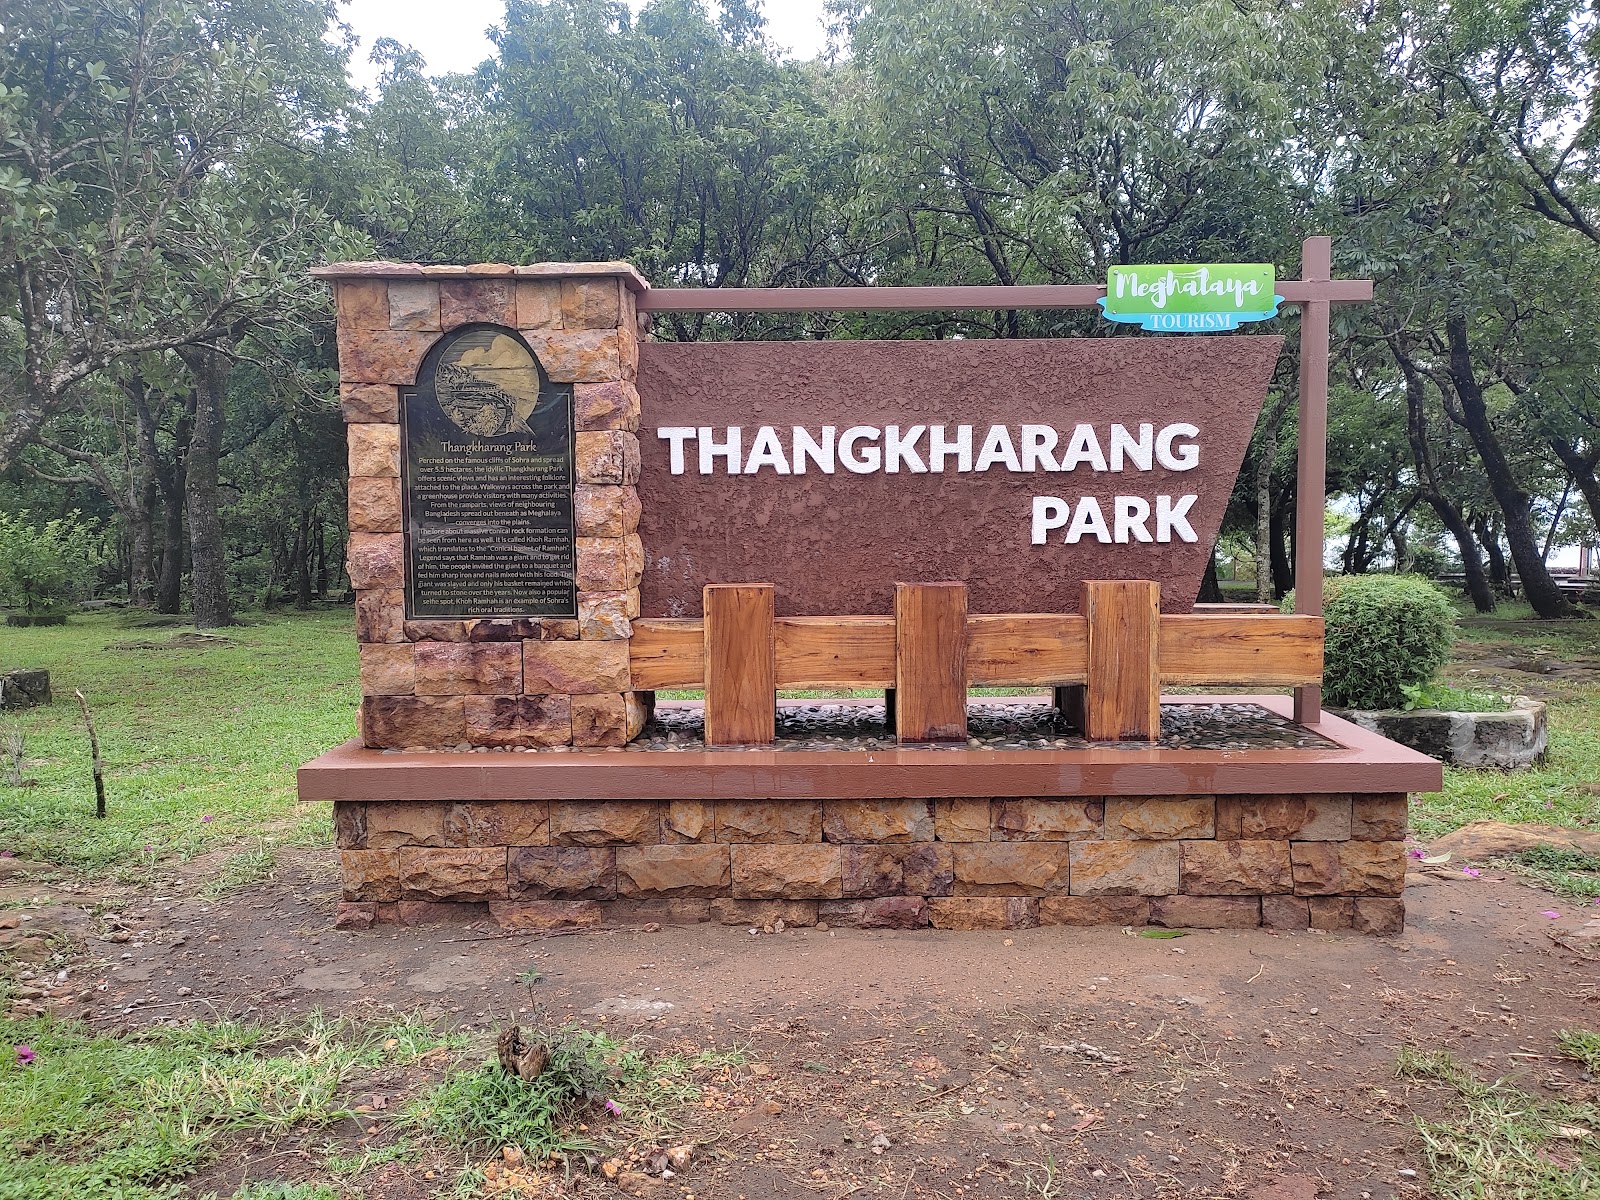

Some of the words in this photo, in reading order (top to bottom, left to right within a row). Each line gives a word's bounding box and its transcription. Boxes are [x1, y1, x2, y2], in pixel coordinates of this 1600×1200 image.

[1116, 267, 1264, 309] Meghalaya
[1151, 313, 1231, 329] TOURISM
[440, 440, 512, 456] Thangkharang
[514, 440, 537, 452] Park
[657, 422, 1200, 476] THANGKHARANG
[485, 466, 504, 474] idyllic
[504, 466, 548, 474] Thangkharang
[461, 484, 479, 492] place.
[543, 483, 558, 491] park
[421, 493, 458, 501] greenhouse
[458, 492, 483, 501] provide
[459, 501, 489, 509] ramparts,
[515, 501, 555, 509] neighbouring
[424, 510, 460, 518] Bangladesh
[461, 510, 482, 518] spread
[528, 510, 561, 518] Meghalaya
[511, 519, 532, 527] plains.
[1031, 494, 1198, 546] PARK
[513, 554, 529, 562] giant
[549, 554, 560, 562] get
[450, 563, 471, 571] people
[441, 572, 459, 580] sharp
[546, 589, 570, 597] popular
[513, 597, 539, 605] example
